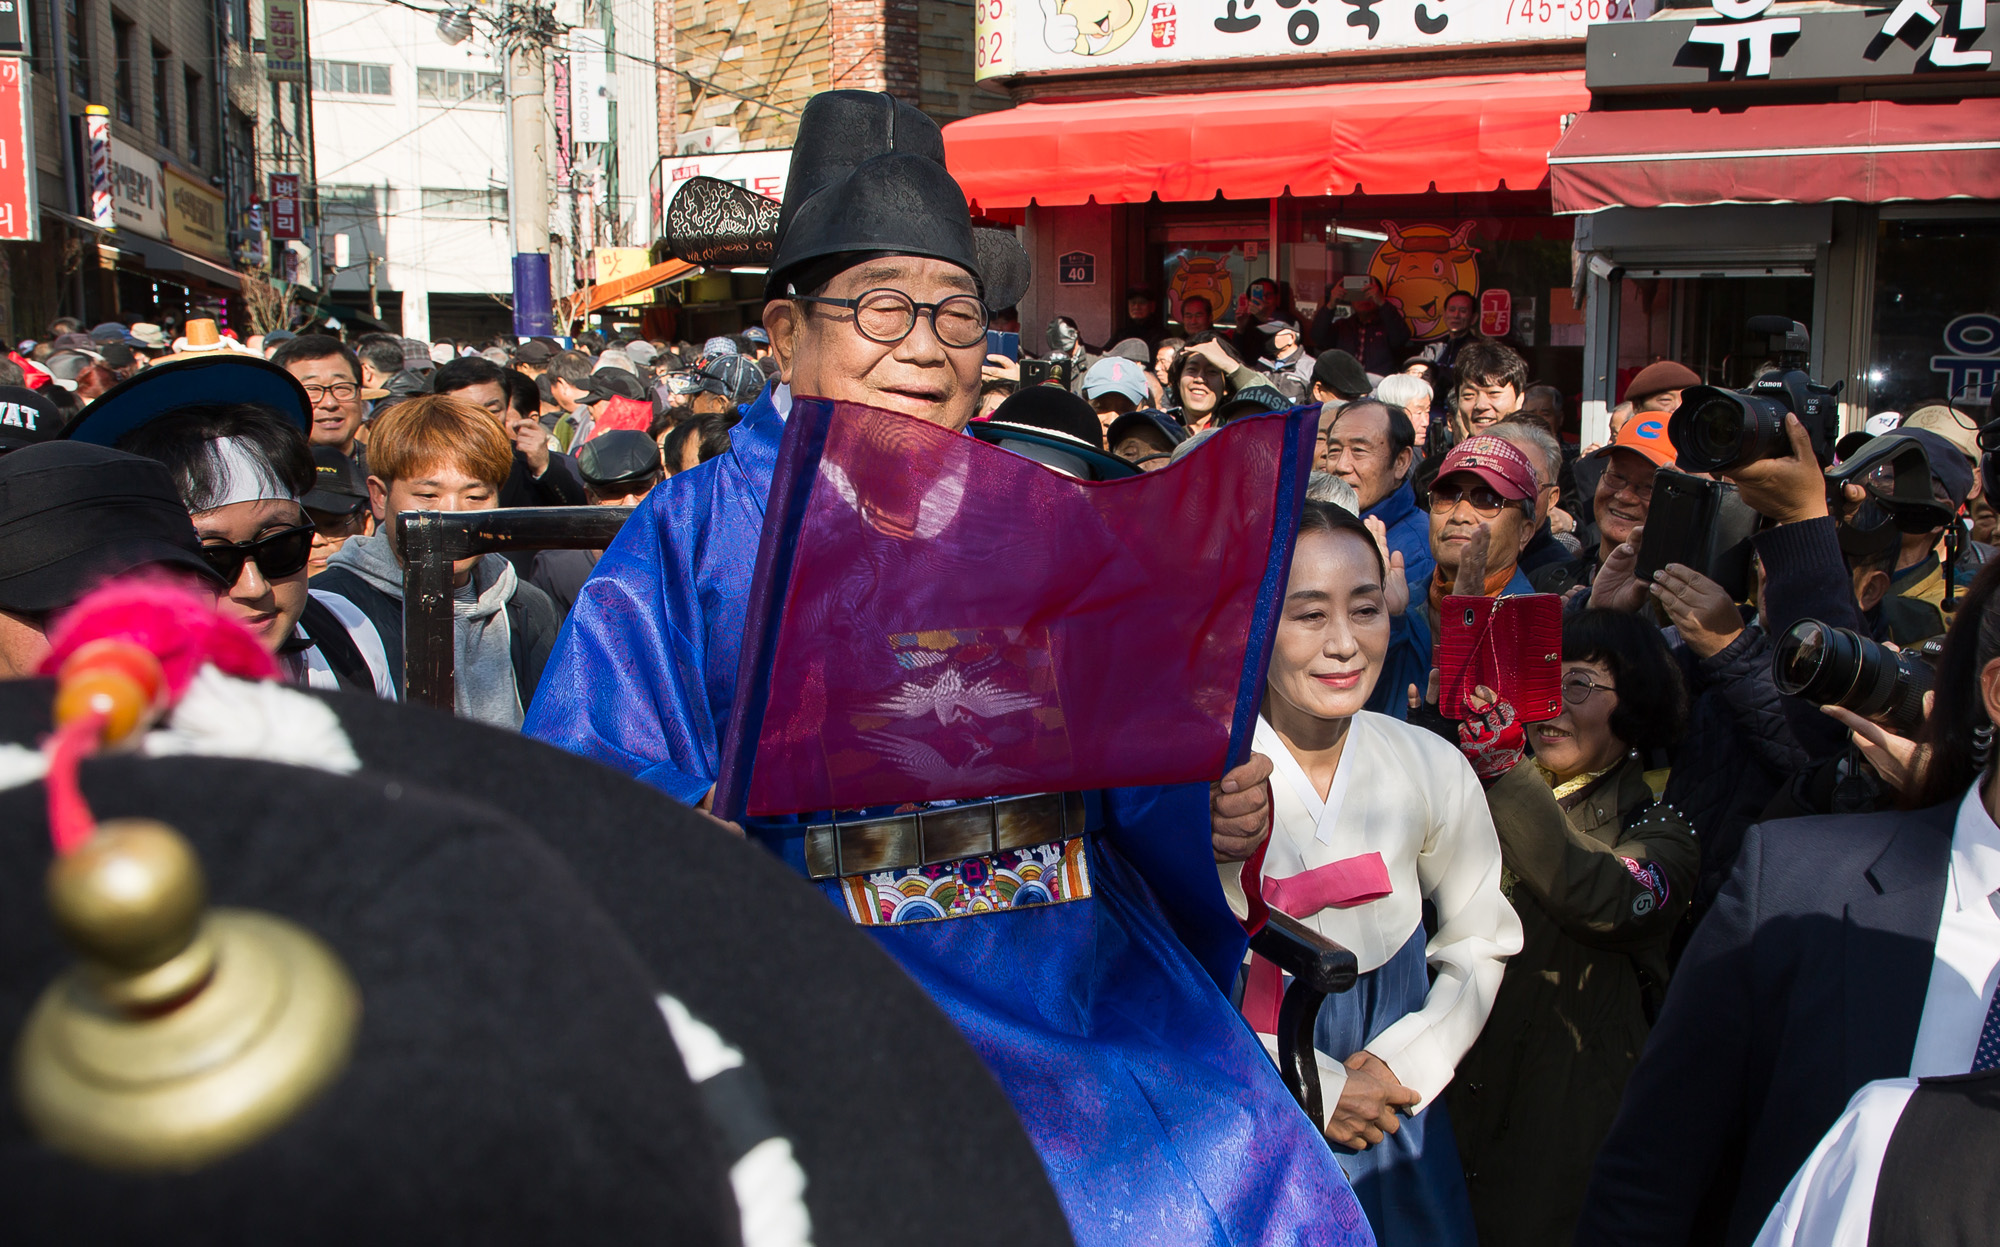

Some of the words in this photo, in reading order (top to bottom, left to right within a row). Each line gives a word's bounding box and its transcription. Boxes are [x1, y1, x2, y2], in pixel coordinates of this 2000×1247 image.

[1068, 267, 1085, 280] 40
[1923, 641, 1944, 652] Niko
[1636, 899, 1651, 911] 5
